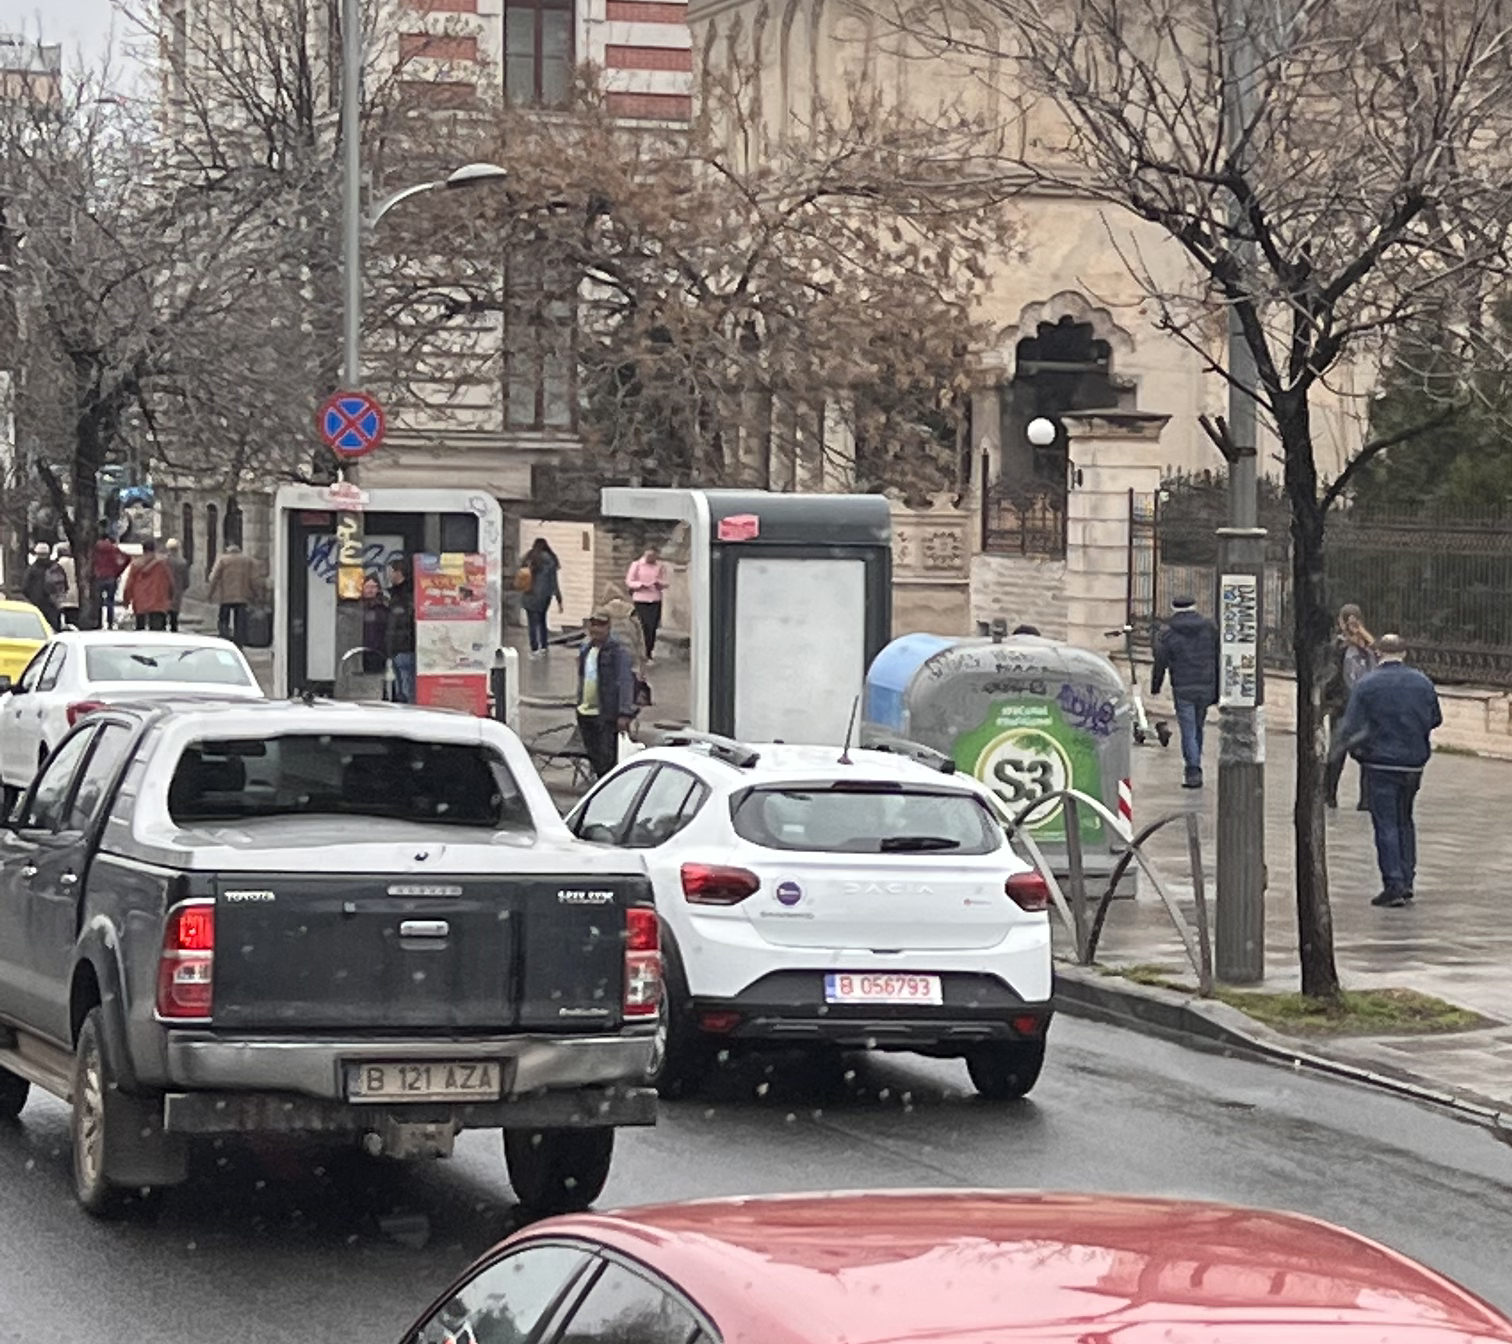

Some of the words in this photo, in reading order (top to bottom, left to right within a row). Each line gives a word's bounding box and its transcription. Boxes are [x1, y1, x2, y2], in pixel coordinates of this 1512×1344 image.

[991, 758, 1054, 803] S3
[224, 890, 276, 902] TOYOTA
[843, 881, 936, 896] DACIA
[839, 976, 854, 995] B
[860, 977, 932, 997] 056793
[366, 1066, 385, 1091] B
[398, 1065, 432, 1091] 121
[445, 1064, 493, 1089] AZA
